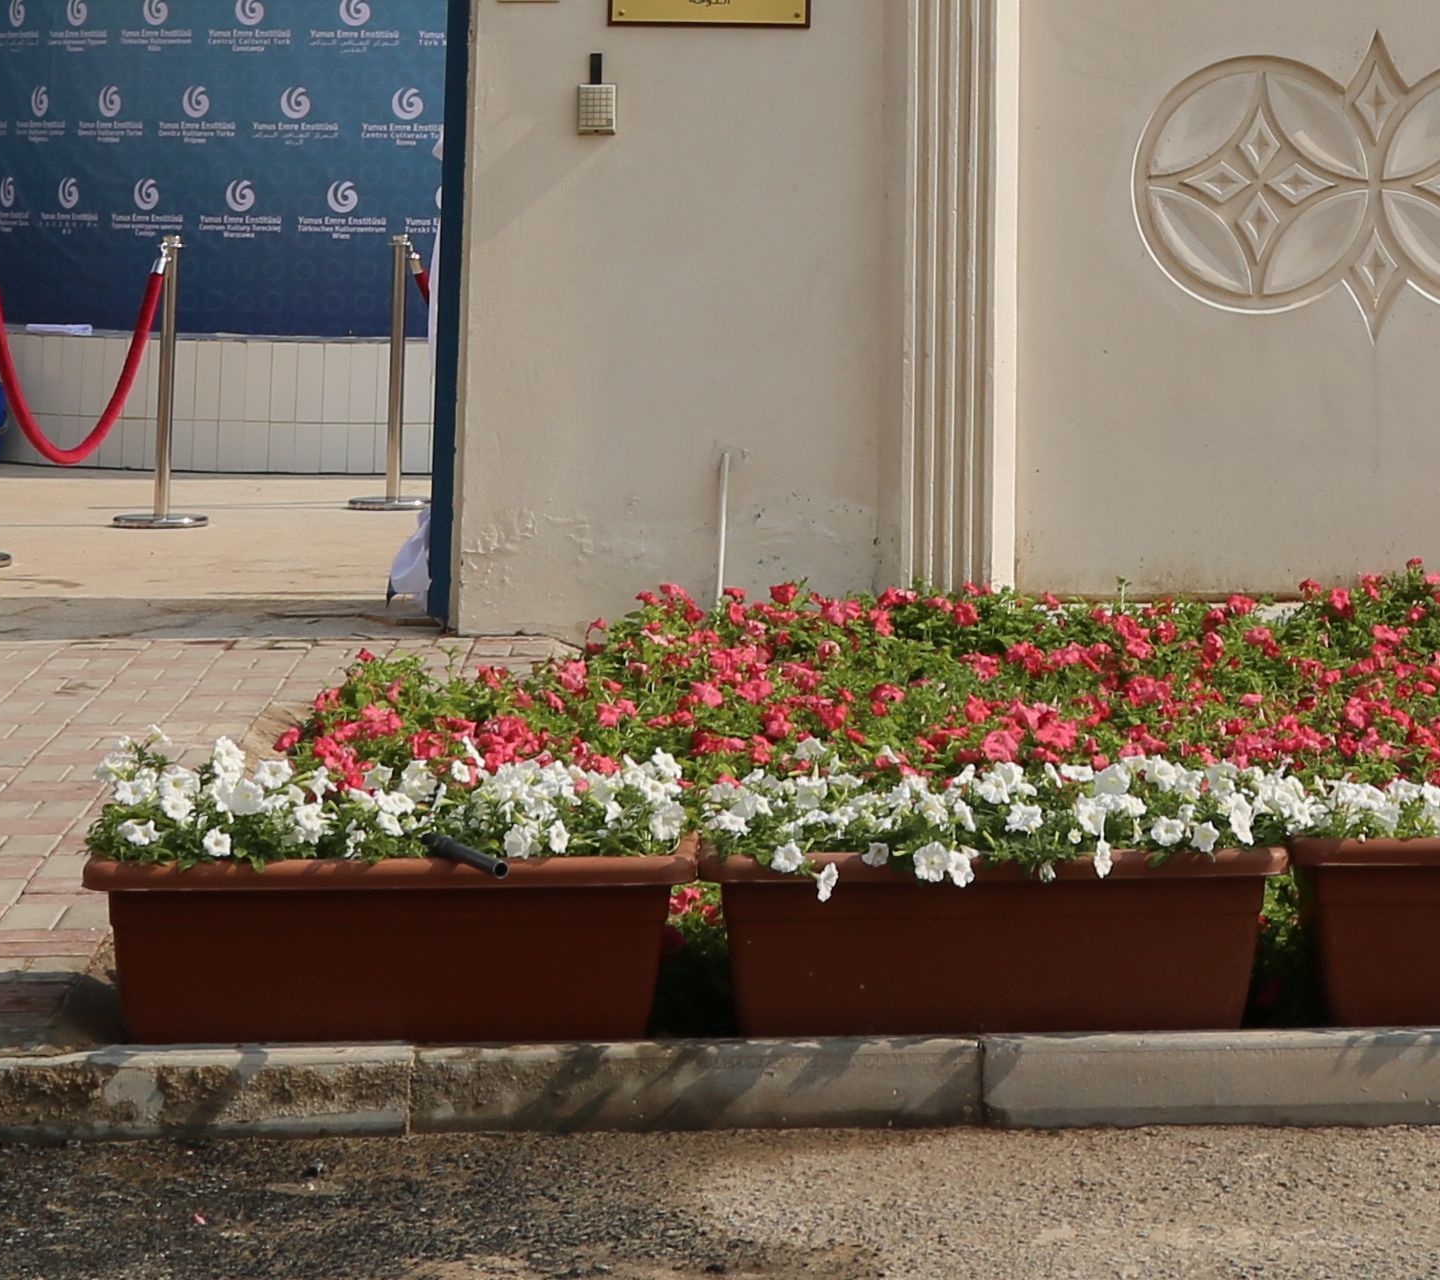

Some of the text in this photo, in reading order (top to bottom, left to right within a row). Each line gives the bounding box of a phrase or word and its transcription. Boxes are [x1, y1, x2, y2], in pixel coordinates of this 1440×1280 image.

[298, 216, 323, 225] Yunus
[324, 216, 346, 225] Emre
[405, 217, 432, 226] Yunus
